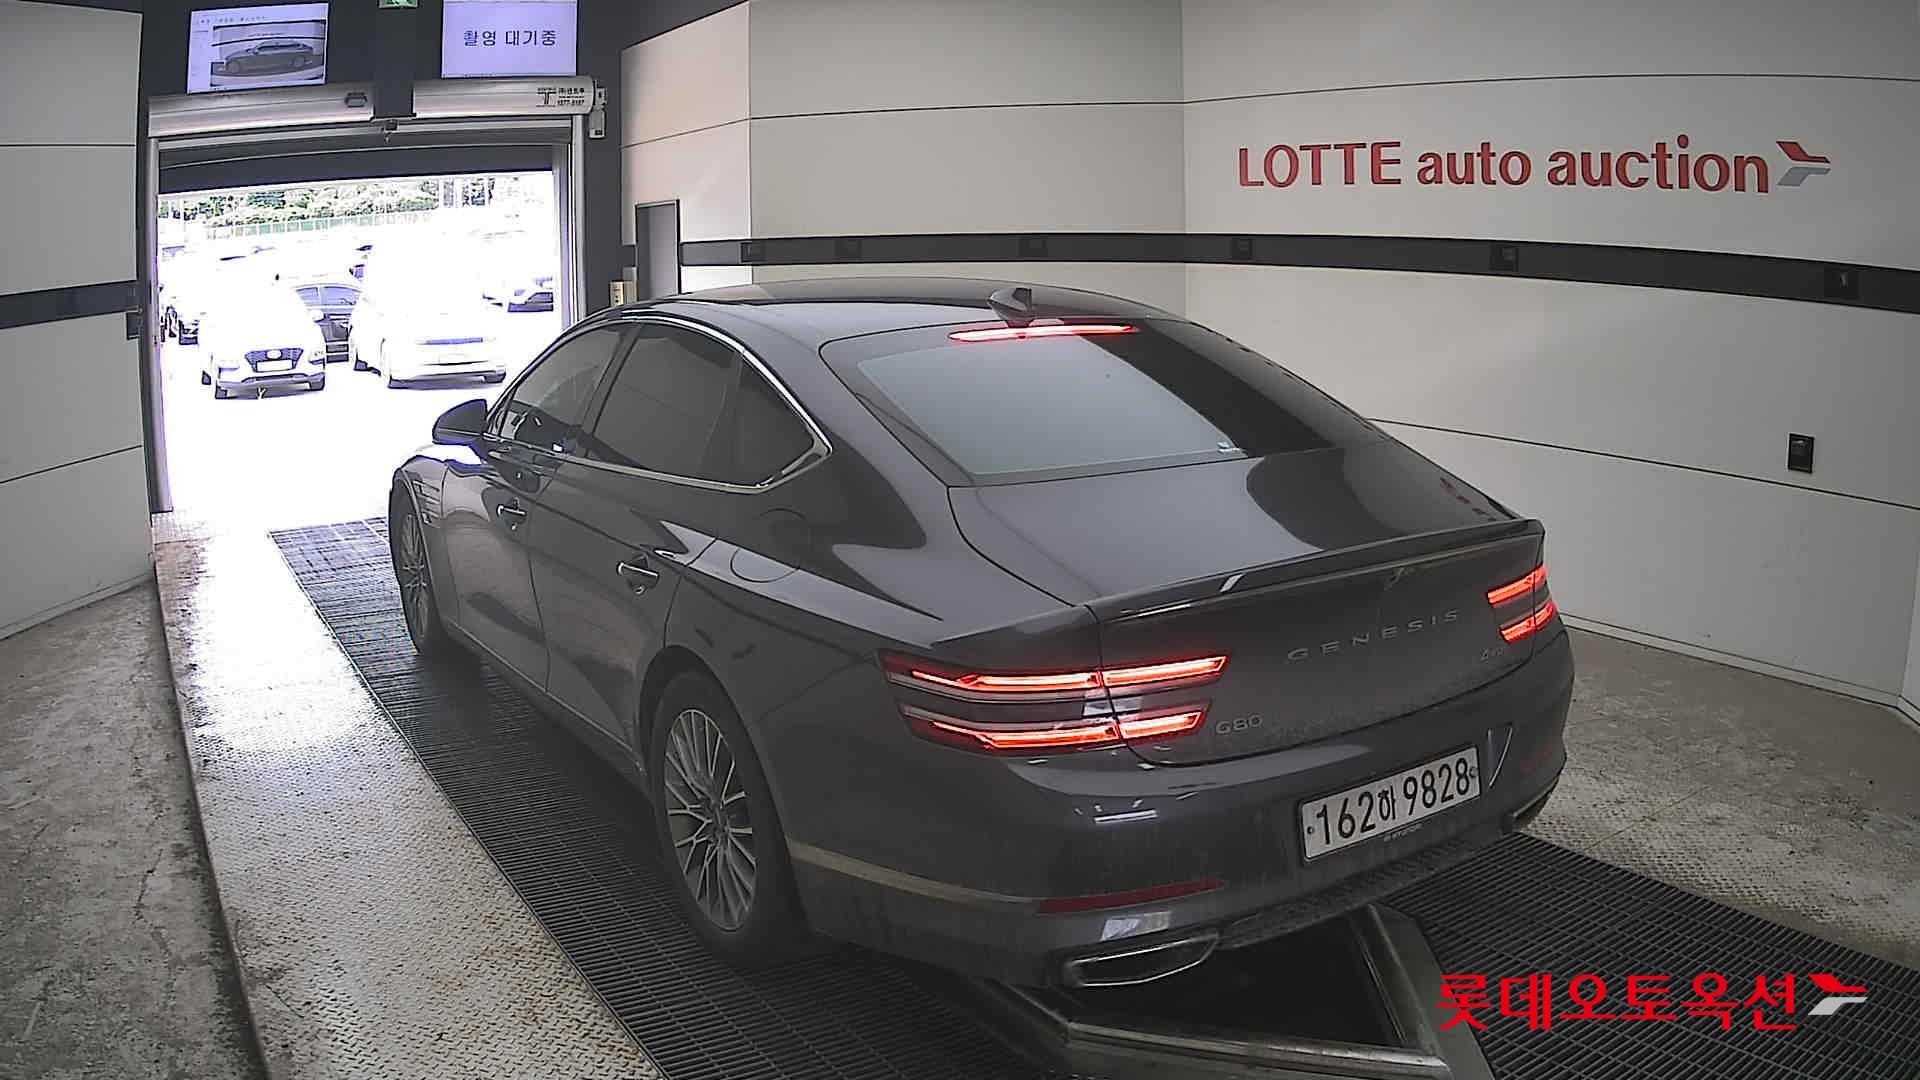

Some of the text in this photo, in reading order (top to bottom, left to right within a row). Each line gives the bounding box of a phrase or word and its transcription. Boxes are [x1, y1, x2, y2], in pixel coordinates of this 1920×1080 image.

[463, 30, 557, 47] 촬영 대기중
[1239, 134, 1769, 193] LOTTE auto auction
[1287, 609, 1459, 661] GENESIS
[1215, 714, 1263, 735] G80
[1316, 757, 1470, 845] 162하 9828
